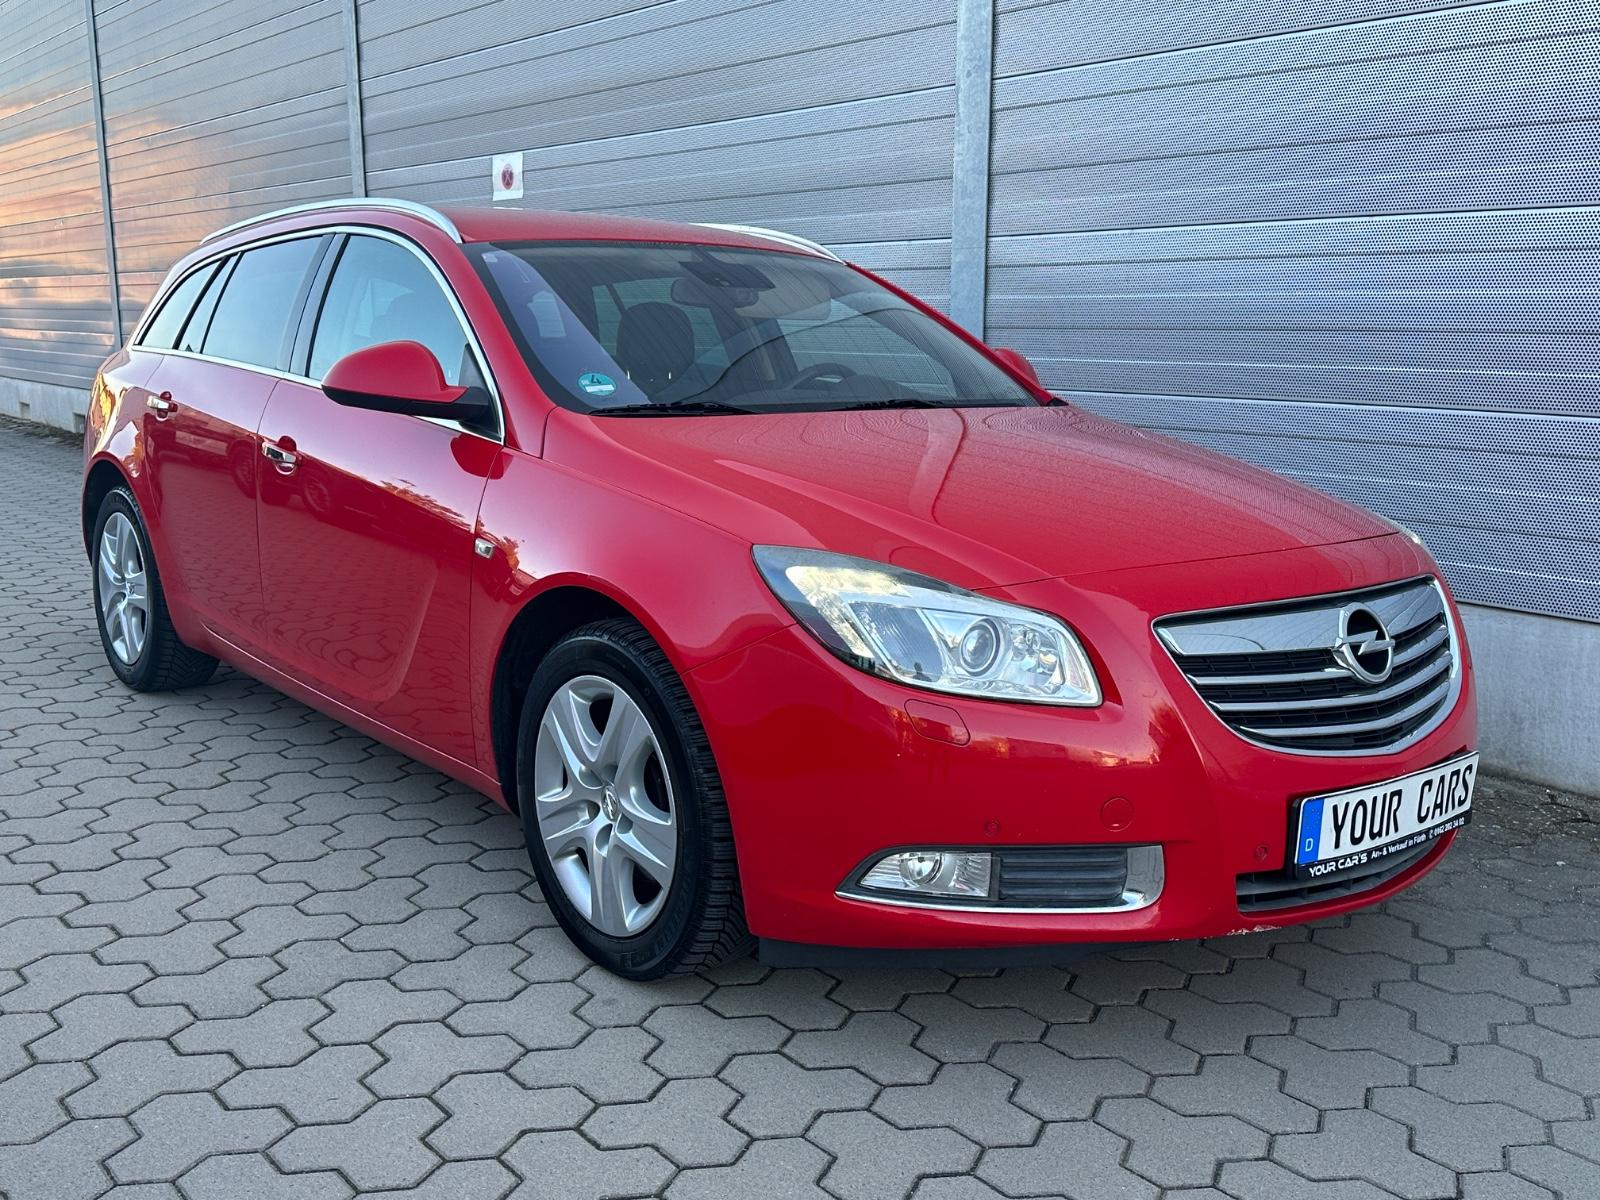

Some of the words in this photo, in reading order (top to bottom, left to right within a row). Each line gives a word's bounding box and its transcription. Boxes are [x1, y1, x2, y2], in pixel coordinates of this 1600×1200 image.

[1332, 788, 1403, 850] YOUR
[1417, 763, 1473, 824] CARS
[1305, 838, 1313, 852] D
[1309, 861, 1336, 877] YOUR
[1337, 852, 1368, 869] CAR'S
[1388, 841, 1408, 853] Verkauf
[1414, 834, 1427, 846] Fürth
